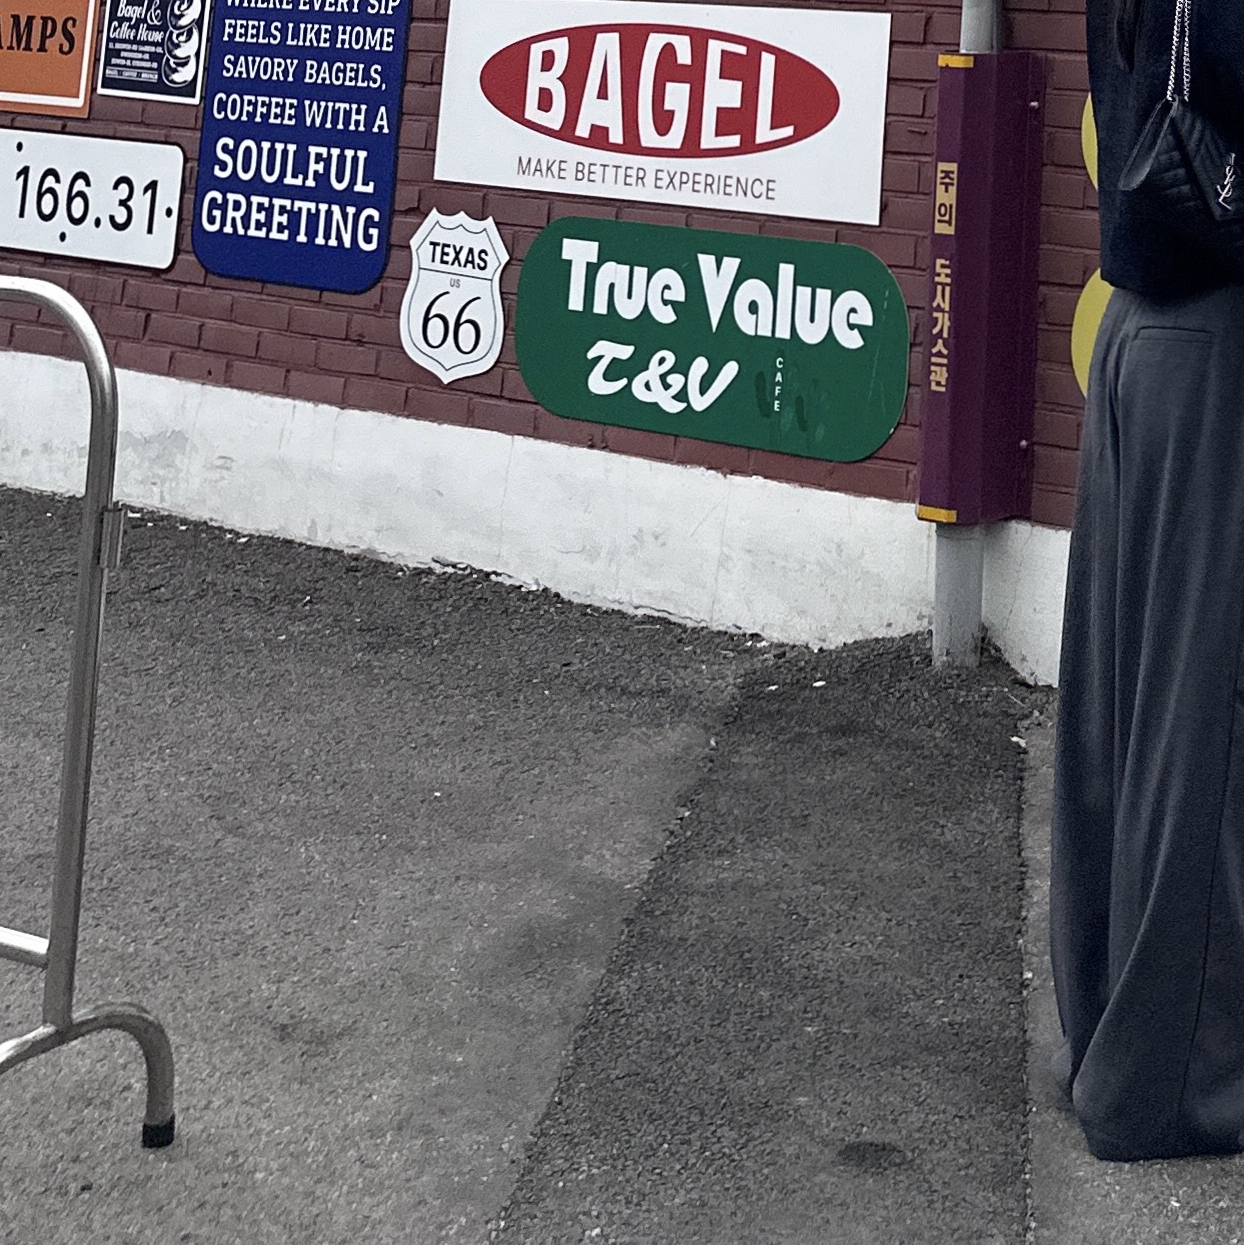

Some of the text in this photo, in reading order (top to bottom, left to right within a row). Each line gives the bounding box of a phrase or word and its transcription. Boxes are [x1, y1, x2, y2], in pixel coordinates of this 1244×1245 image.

[0, 12, 77, 55] MPS
[109, 20, 165, 44] Coffee House
[222, 19, 395, 52] FEELS LIKE HOME
[222, 54, 387, 91] SAVORY BAGELS,
[523, 31, 795, 150] BAGEL
[212, 92, 390, 134] COFFEE WITH A
[213, 137, 375, 194] SOULFUL
[516, 156, 777, 201] MAKE BETTER EXPERIENCE
[201, 190, 380, 252] GREETING
[938, 168, 955, 228] 주의
[429, 240, 489, 272] TEXAS
[449, 277, 462, 290] US
[561, 237, 874, 350] True Value
[421, 289, 482, 356] 66
[929, 258, 952, 393] 도시가스관
[773, 356, 784, 412] CAFE
